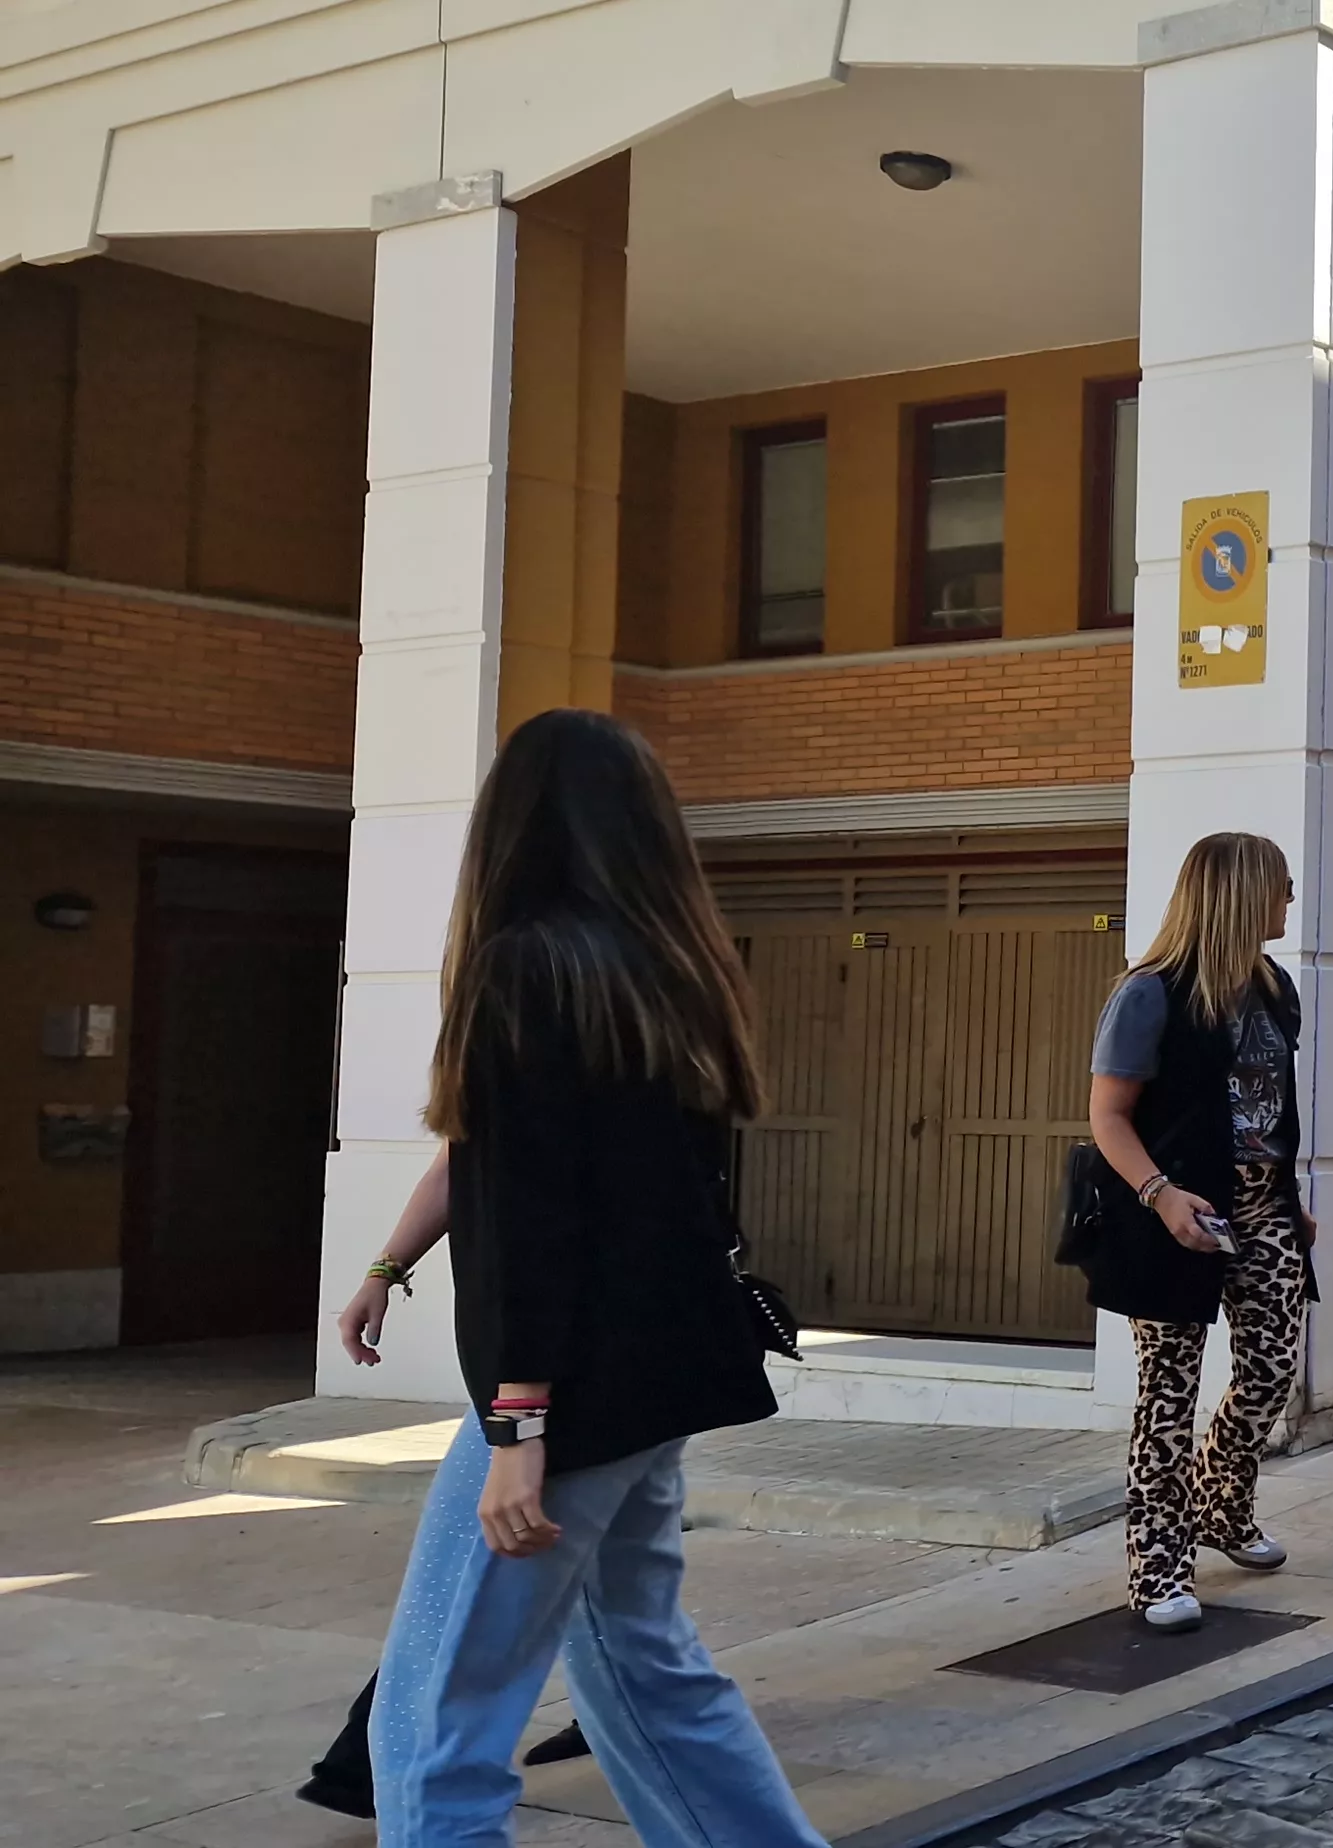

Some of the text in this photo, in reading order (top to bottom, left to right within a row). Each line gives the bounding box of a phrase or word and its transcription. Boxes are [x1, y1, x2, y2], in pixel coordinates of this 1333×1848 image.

[1186, 517, 1208, 552] SALIDA
[1211, 508, 1222, 519] DE
[1180, 653, 1186, 664] 4
